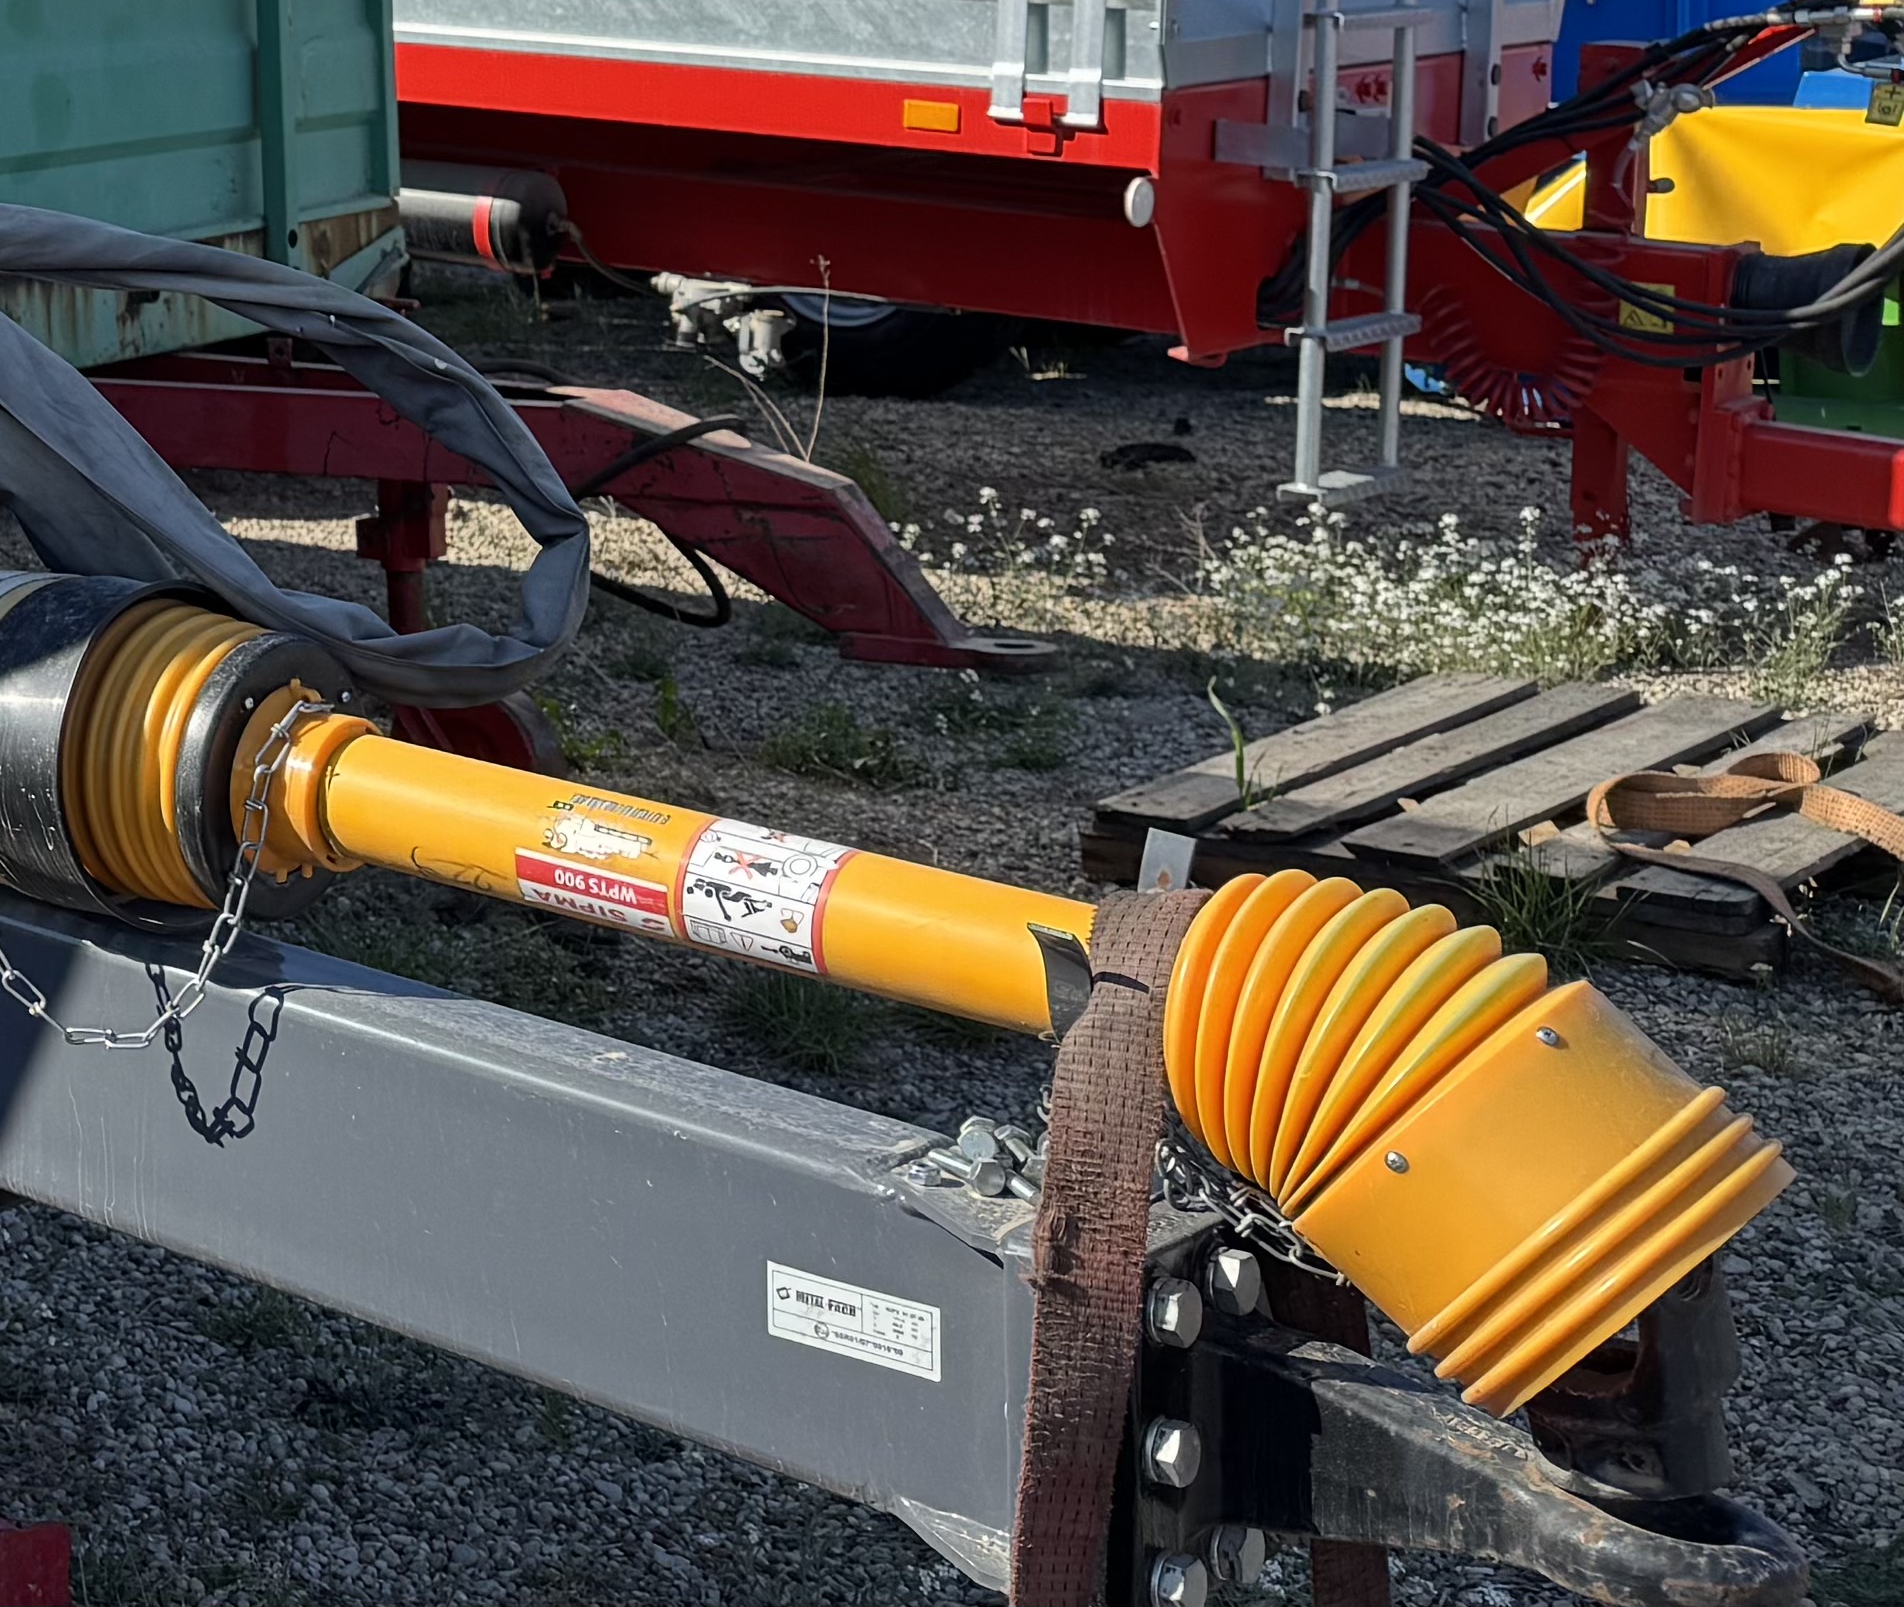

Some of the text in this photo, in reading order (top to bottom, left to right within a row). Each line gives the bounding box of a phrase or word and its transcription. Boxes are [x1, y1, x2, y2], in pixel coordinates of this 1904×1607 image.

[554, 868, 638, 905] WPTS 900
[531, 887, 628, 923] SIPMA
